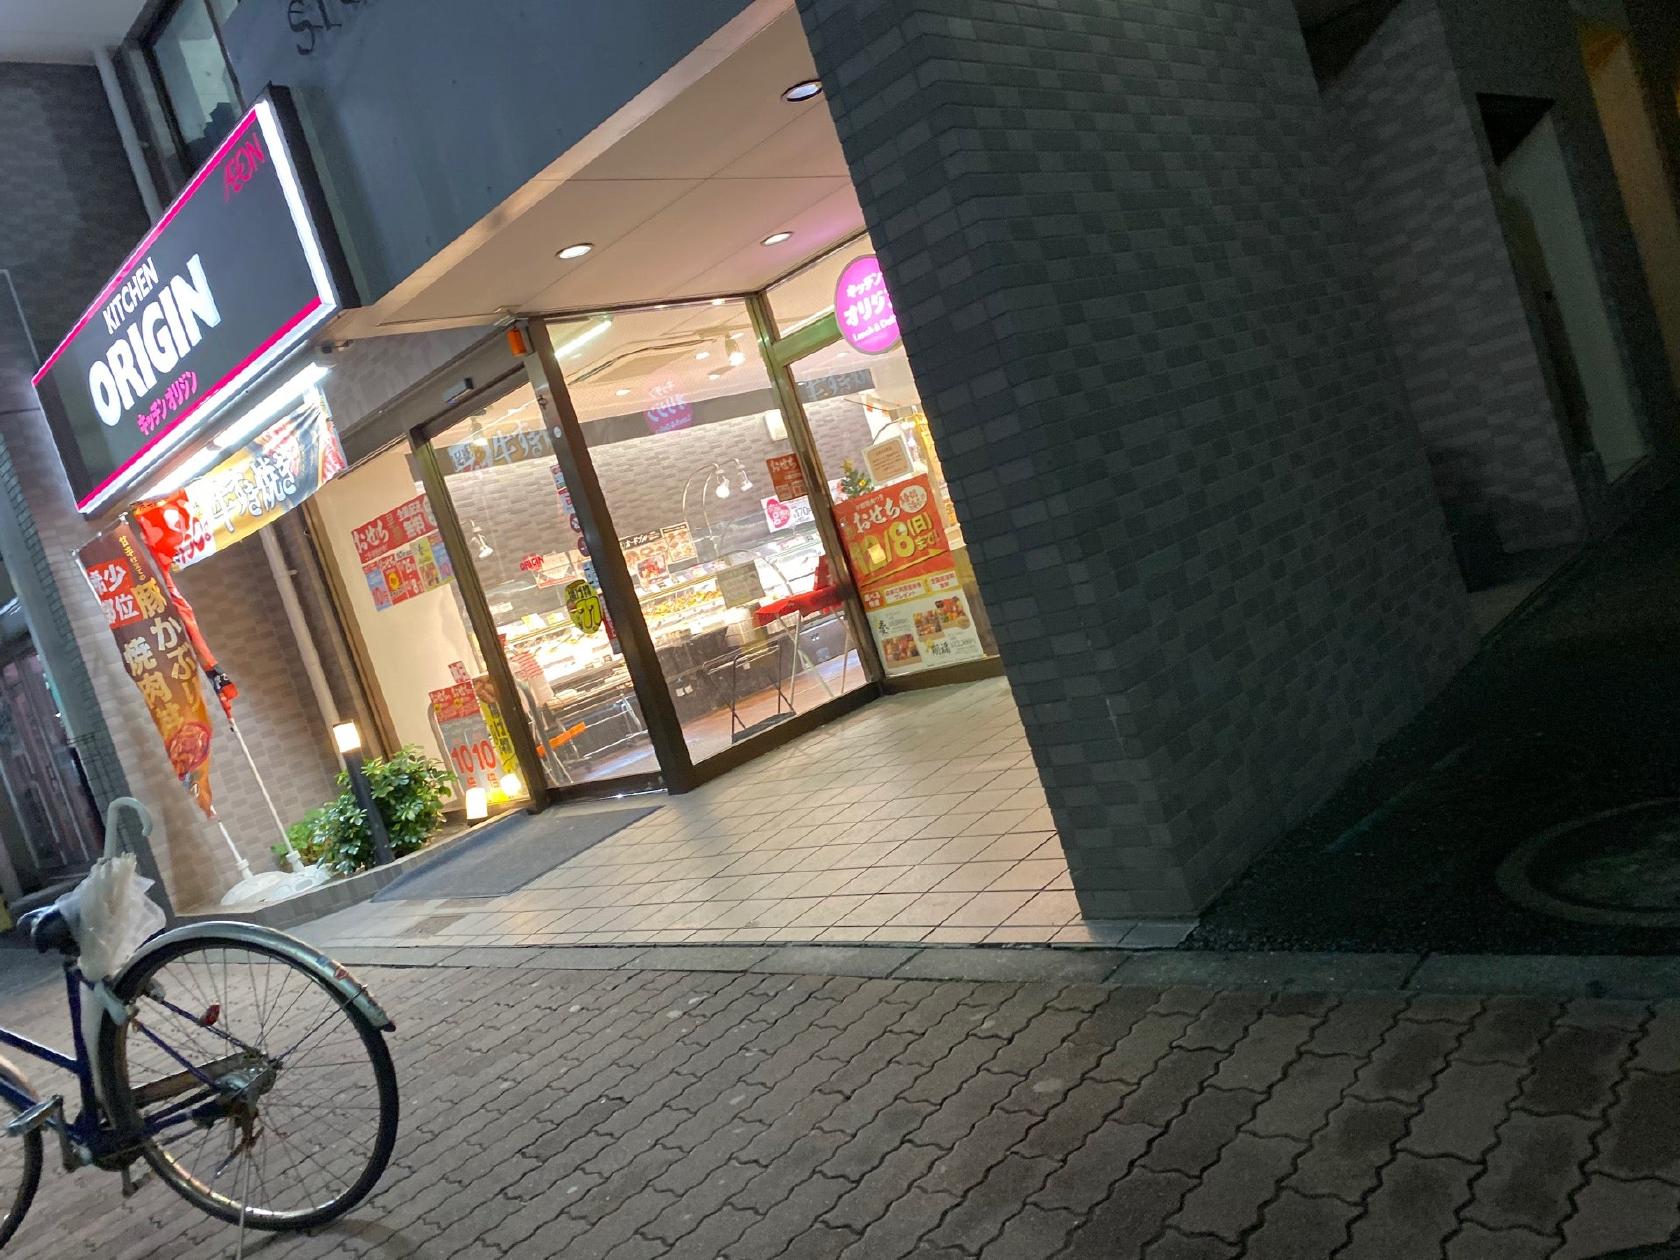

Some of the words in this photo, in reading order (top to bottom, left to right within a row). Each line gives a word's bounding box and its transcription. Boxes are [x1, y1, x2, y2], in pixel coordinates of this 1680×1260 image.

[103, 256, 159, 335] KITCHEN
[89, 253, 221, 427] ORIGIN
[136, 371, 198, 436] キッチンオリジン
[853, 497, 901, 534] おせち
